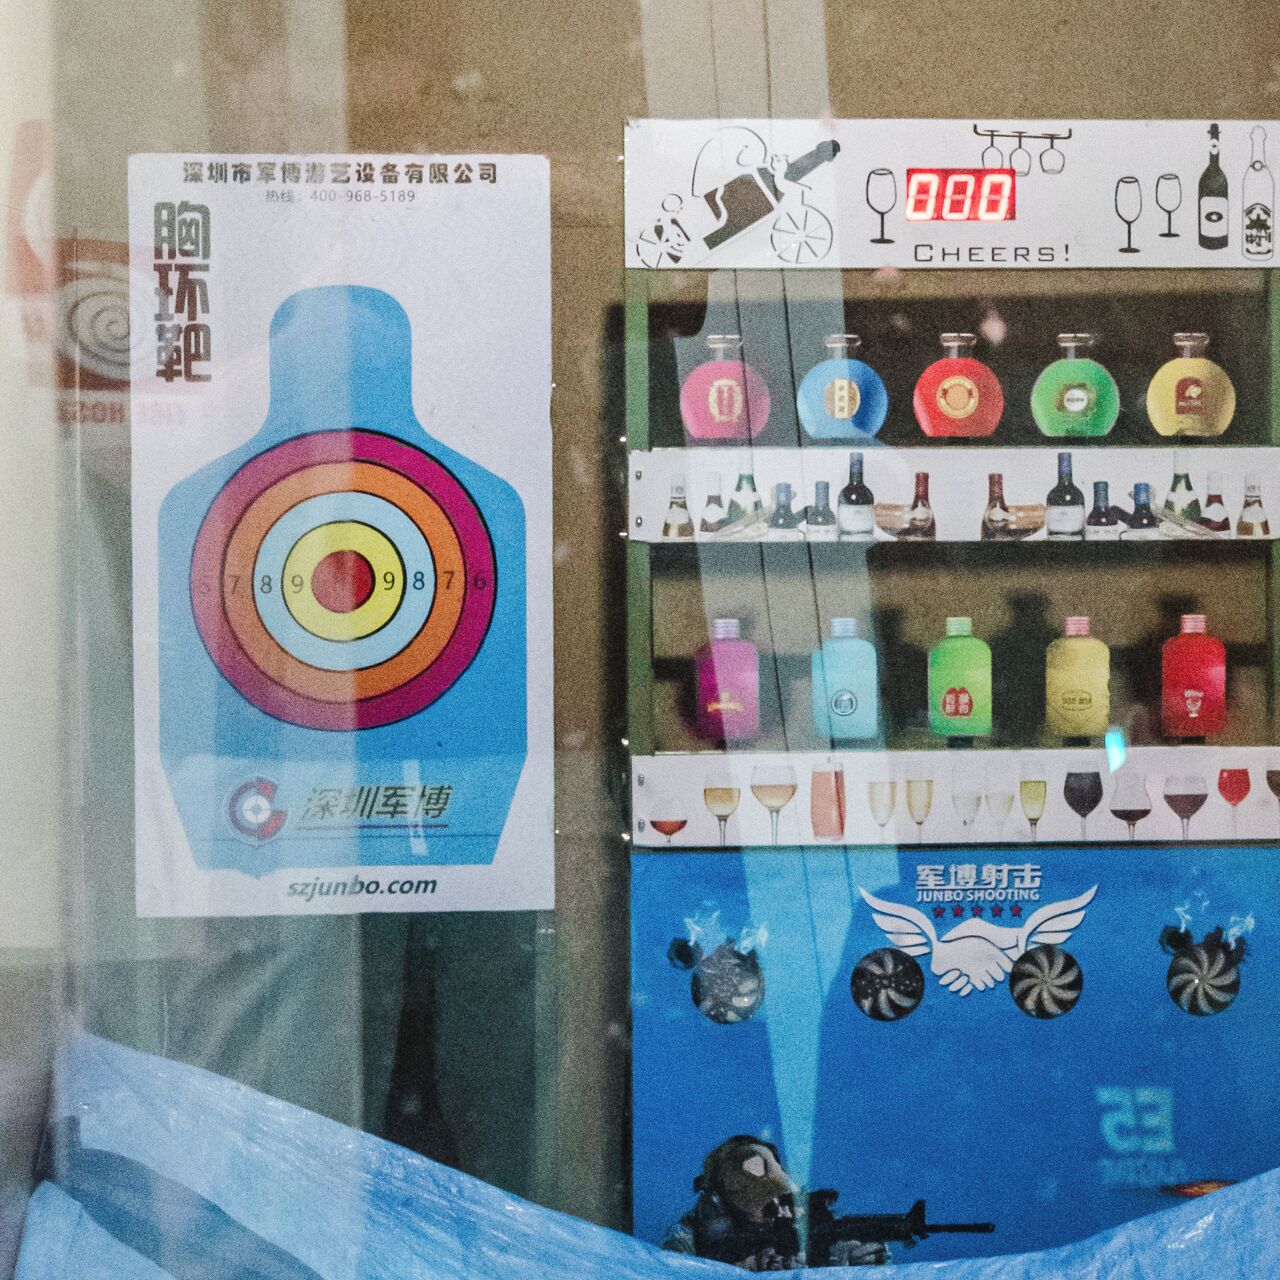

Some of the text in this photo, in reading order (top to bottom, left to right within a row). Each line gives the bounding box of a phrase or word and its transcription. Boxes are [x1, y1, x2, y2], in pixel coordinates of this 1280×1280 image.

[183, 161, 497, 185] 深圳市军博游艺设备有限公司
[309, 189, 416, 202] 400-968-5189
[905, 173, 1012, 220] 000
[913, 243, 1070, 262] CHEERS!
[153, 200, 213, 382] 胸环靶
[228, 574, 240, 594] 7
[260, 574, 273, 594] 8
[291, 574, 304, 594] 9
[382, 570, 396, 591] 9
[412, 570, 425, 591] 8
[443, 570, 455, 591] 7
[474, 570, 487, 591] 6
[302, 784, 453, 821] 深圳军博
[287, 874, 438, 903] szjunbo.com
[915, 863, 1042, 889] 军博射击
[916, 888, 1040, 902] JUNBO SHOOTING
